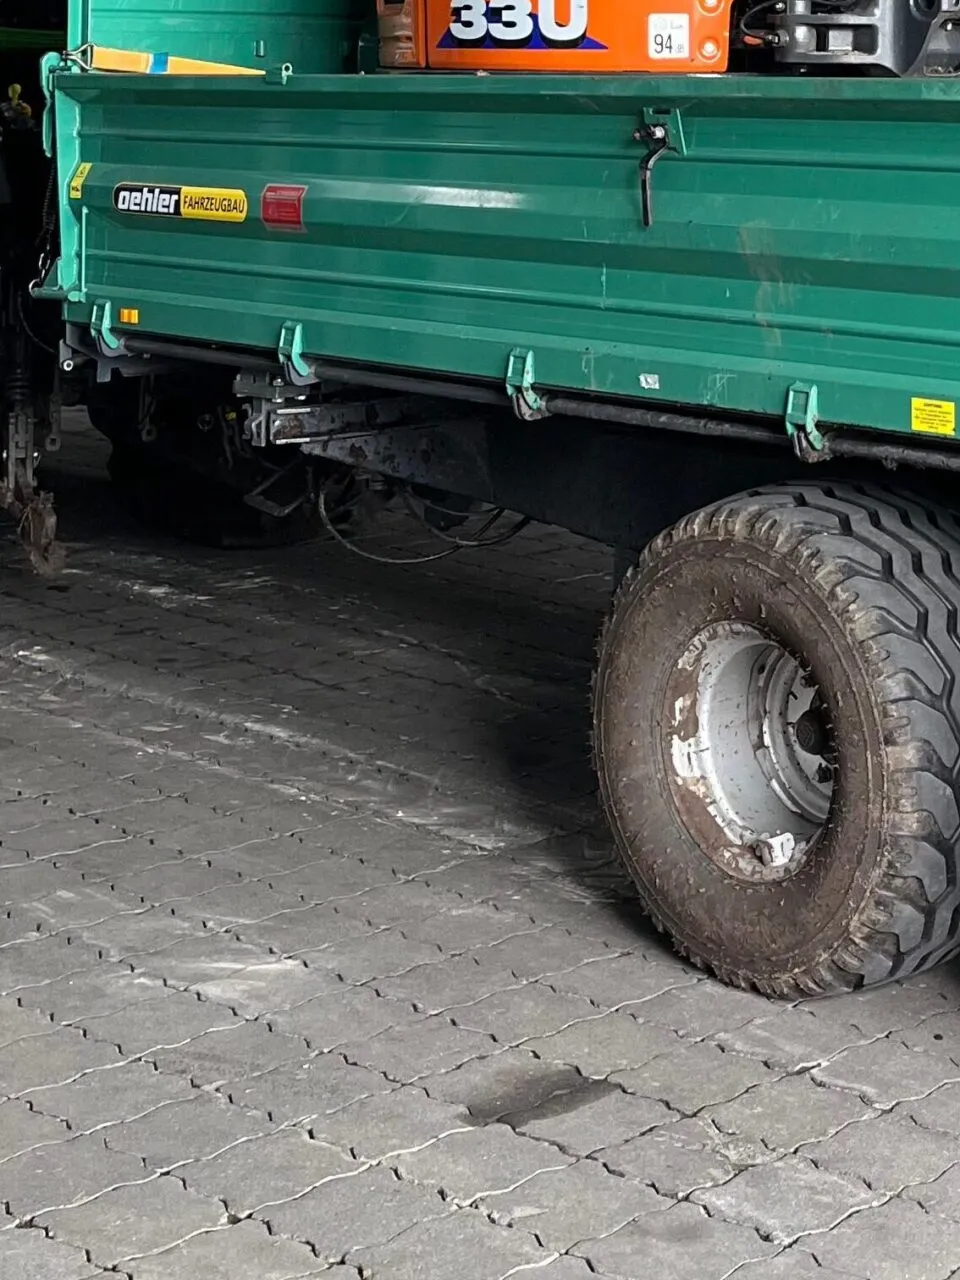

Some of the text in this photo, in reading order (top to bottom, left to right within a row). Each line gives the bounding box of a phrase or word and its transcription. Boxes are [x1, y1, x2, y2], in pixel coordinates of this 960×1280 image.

[654, 33, 672, 54] 94
[117, 187, 179, 214] oehler
[183, 195, 246, 214] FAHRZEUGBAU
